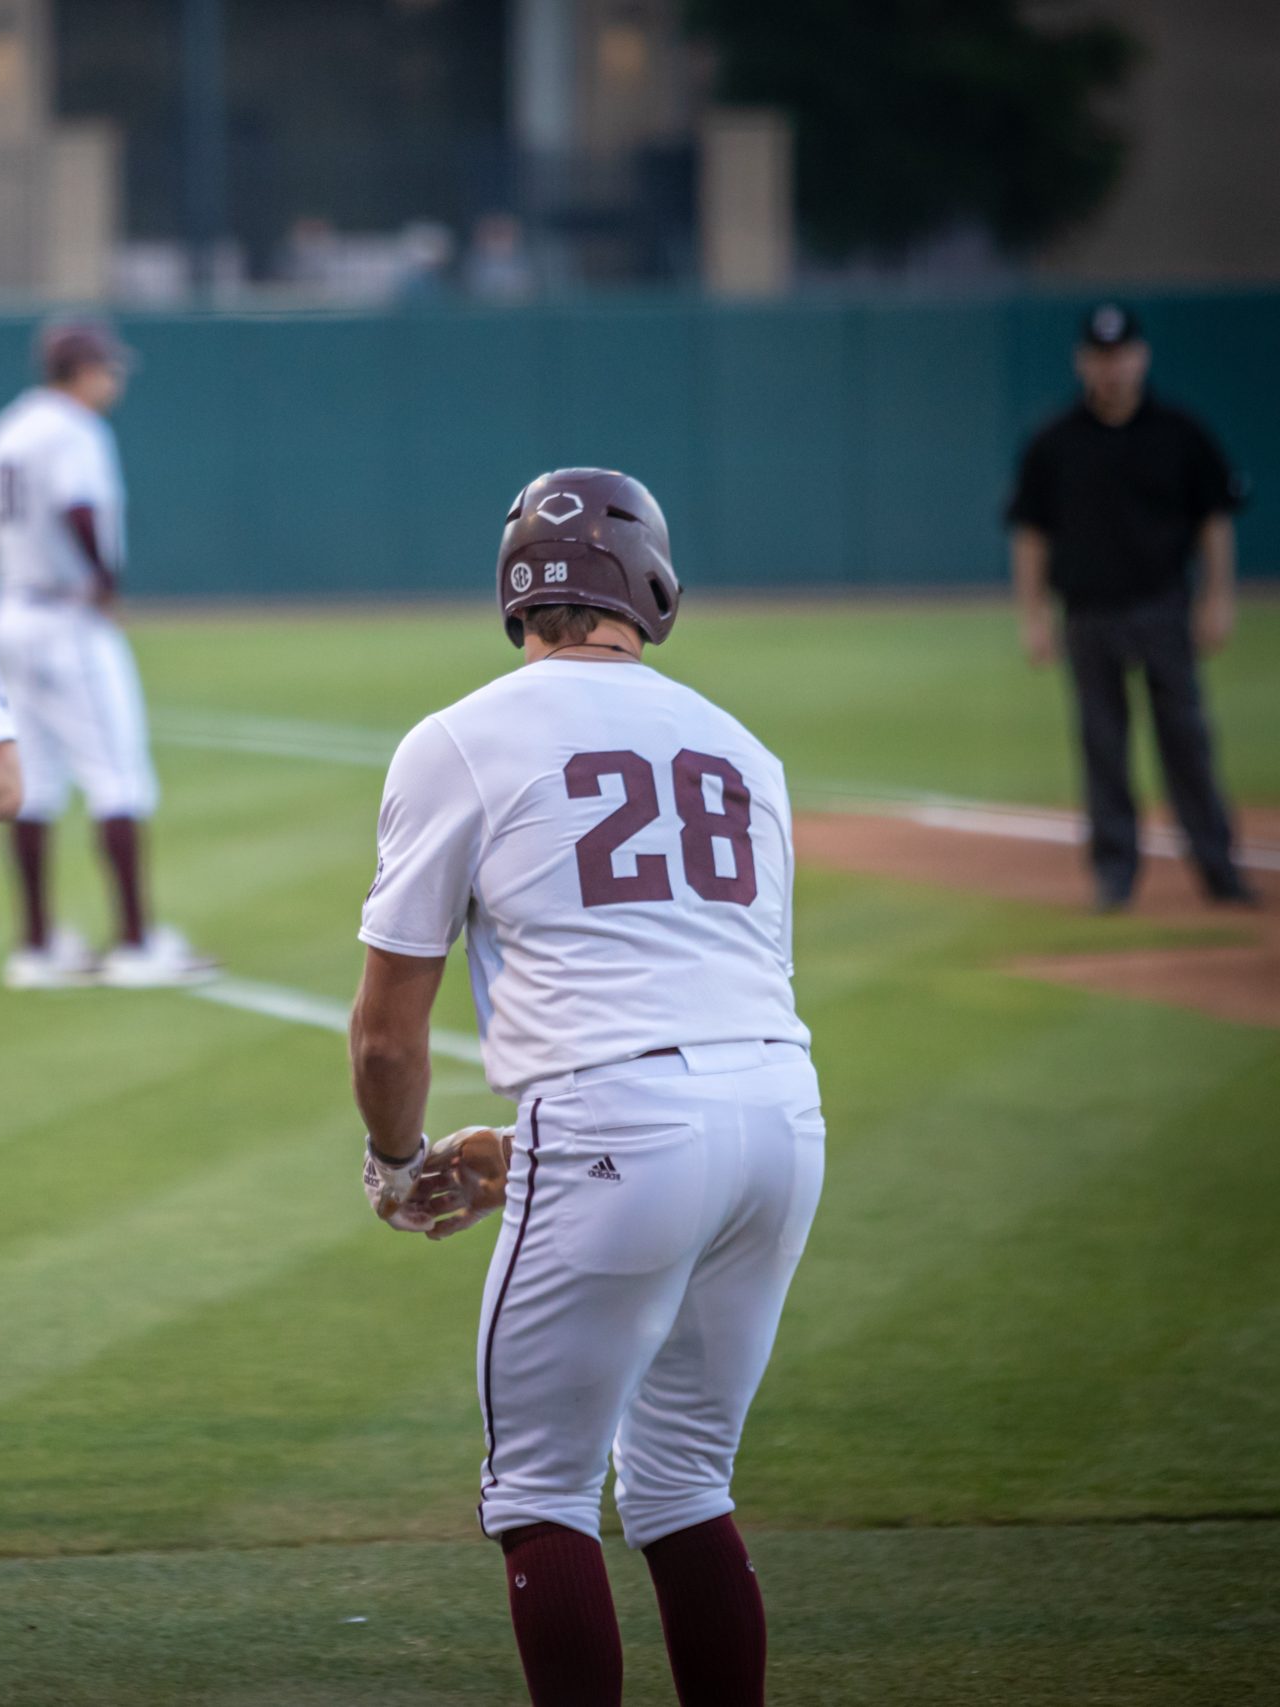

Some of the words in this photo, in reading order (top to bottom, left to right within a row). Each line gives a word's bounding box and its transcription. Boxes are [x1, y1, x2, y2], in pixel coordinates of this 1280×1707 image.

[512, 565, 531, 590] SEC
[544, 561, 568, 583] 28
[563, 748, 757, 907] 28
[588, 1169, 622, 1182] adidas
